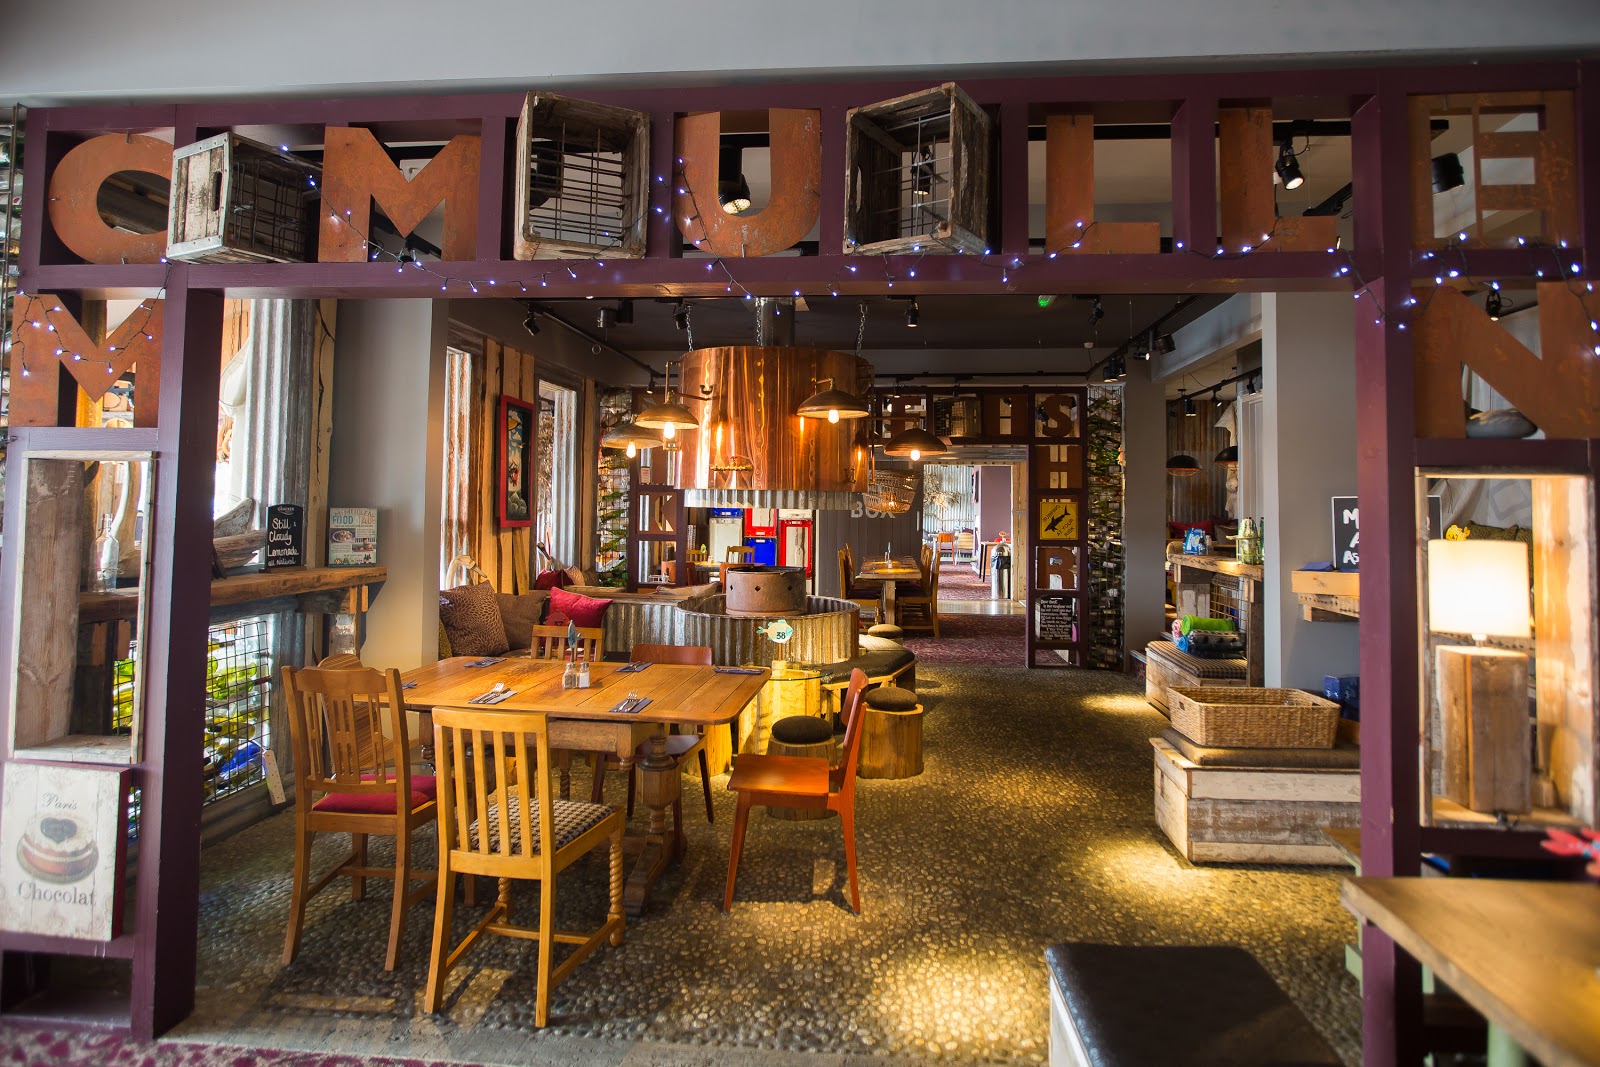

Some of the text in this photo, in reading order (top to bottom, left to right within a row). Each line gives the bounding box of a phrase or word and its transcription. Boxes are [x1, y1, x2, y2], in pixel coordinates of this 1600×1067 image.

[272, 517, 291, 530] Still
[332, 515, 354, 525] FOOD
[1062, 518, 1075, 531] YOUR
[269, 530, 292, 546] Cloudy
[267, 545, 299, 557] Lemonade
[776, 631, 786, 640] 38
[42, 793, 78, 811] Paris
[18, 880, 97, 906] Chocolat
